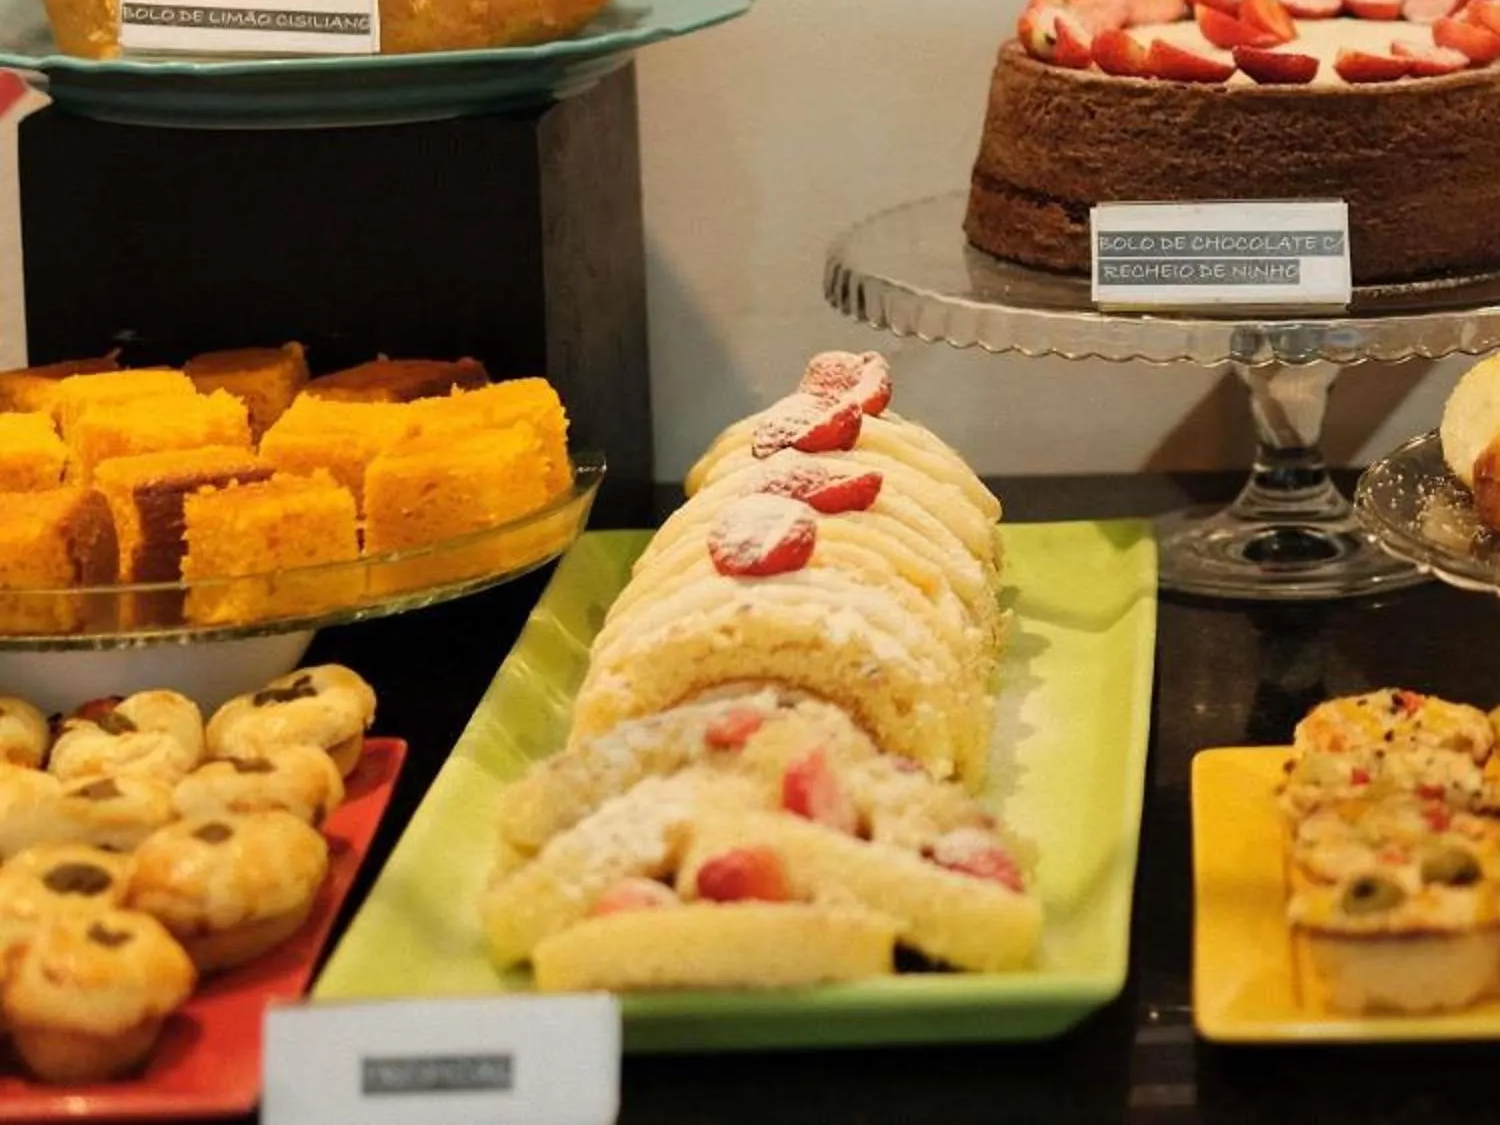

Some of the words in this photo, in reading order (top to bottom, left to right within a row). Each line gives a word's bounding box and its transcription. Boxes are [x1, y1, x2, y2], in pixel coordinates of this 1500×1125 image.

[122, 6, 175, 23] BOLO
[178, 9, 204, 24] DE
[1099, 236, 1154, 251] BOLO
[1160, 236, 1186, 251] DE
[1190, 235, 1317, 252] CHOCOLATE
[1102, 264, 1195, 279] RECHEIO
[1199, 264, 1226, 279] DE
[1231, 263, 1299, 279] NINHO
